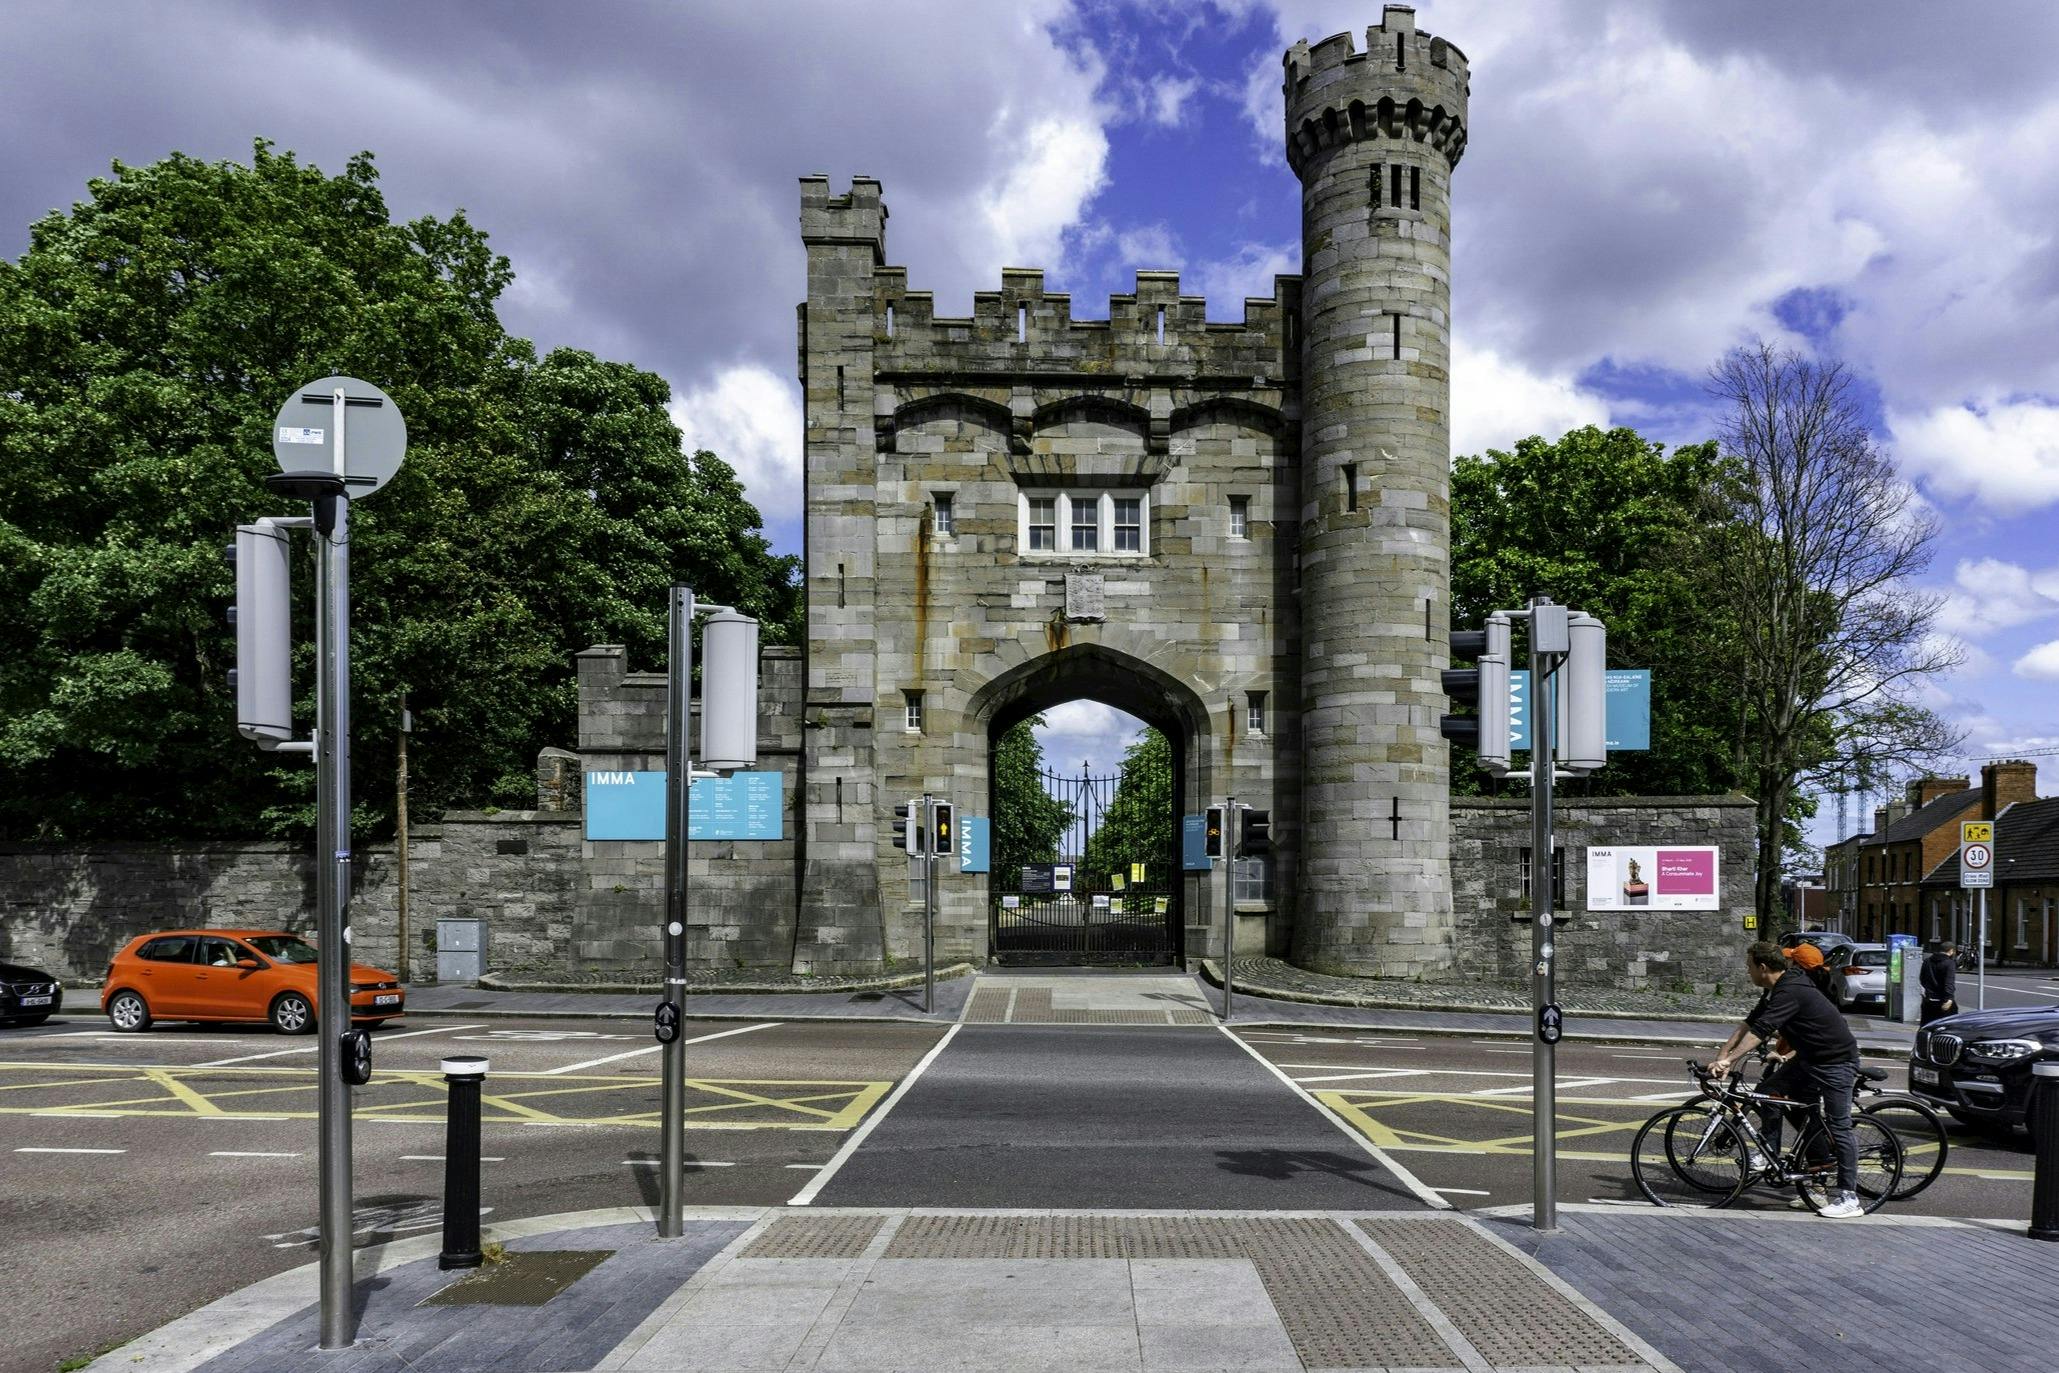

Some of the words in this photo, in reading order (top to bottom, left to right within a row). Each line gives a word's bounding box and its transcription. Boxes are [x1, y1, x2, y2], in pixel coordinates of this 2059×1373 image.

[592, 772, 635, 784] IMMA
[961, 820, 972, 867] IMMA
[1970, 850, 1984, 861] 30
[1747, 917, 1755, 927] H
